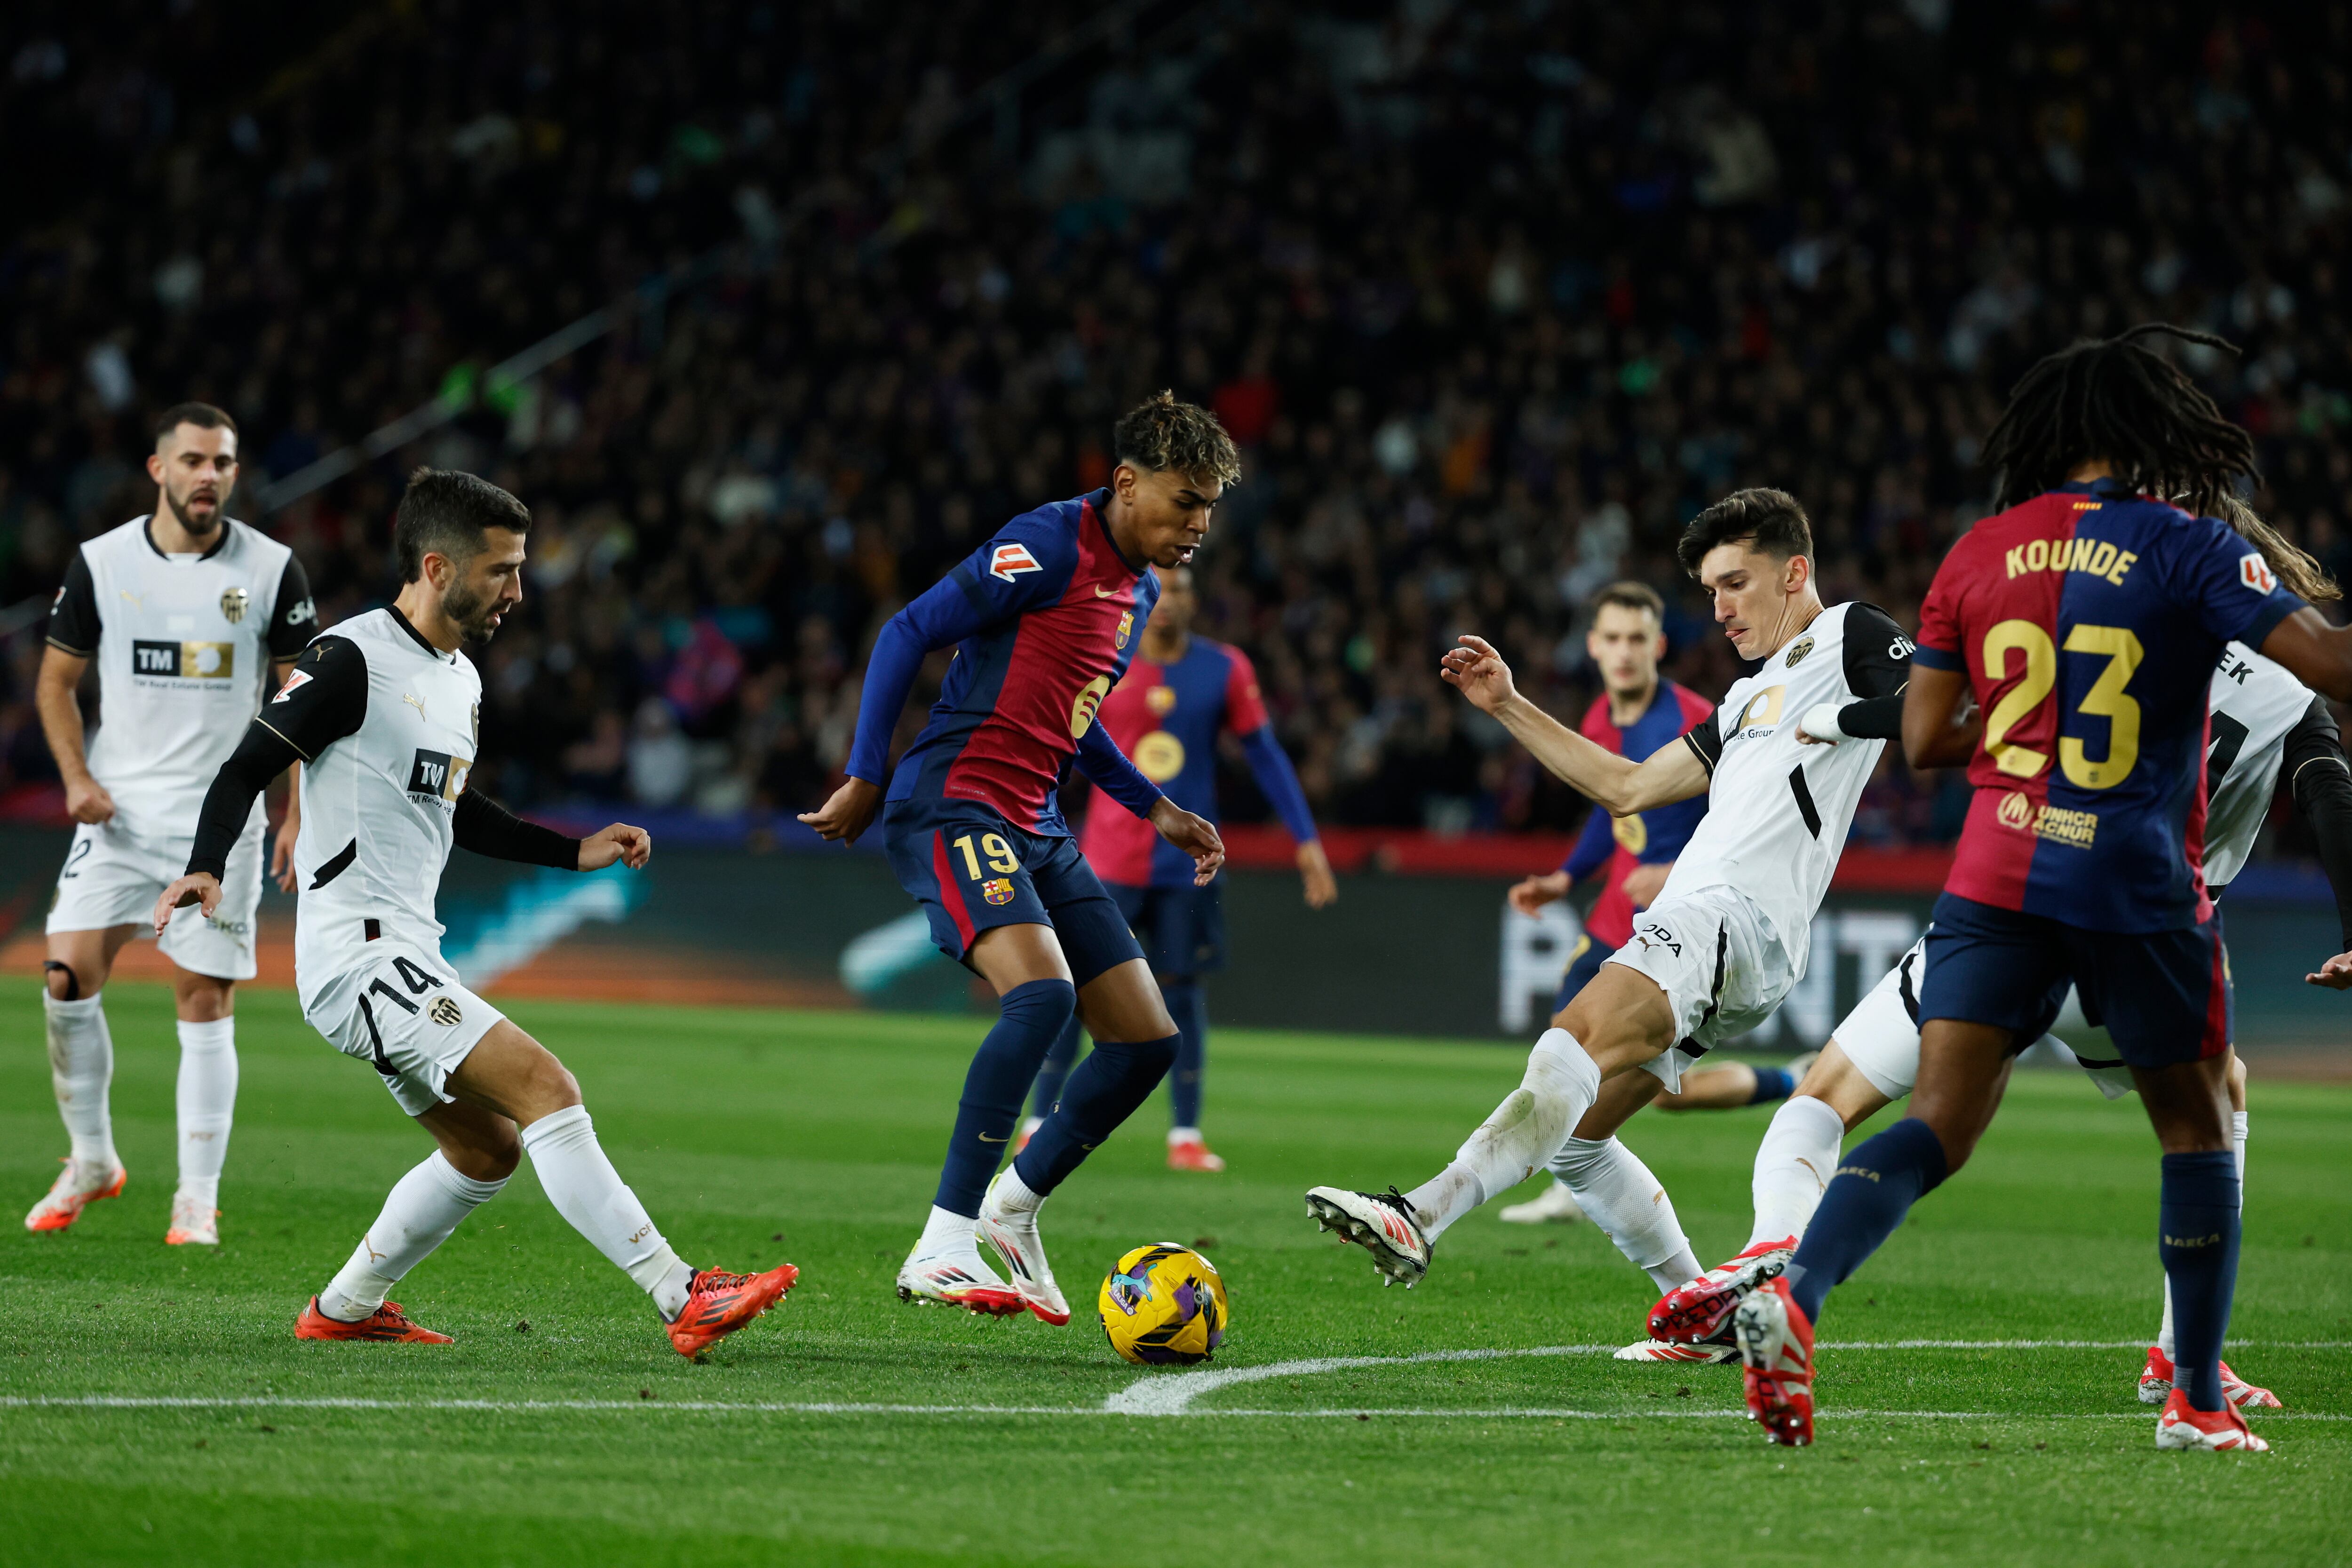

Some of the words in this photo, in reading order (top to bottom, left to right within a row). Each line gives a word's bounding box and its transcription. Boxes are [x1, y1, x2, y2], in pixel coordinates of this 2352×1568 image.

[2005, 538, 2138, 587] KOUNDE
[137, 647, 174, 671] TM
[1982, 619, 2145, 790] 23
[421, 761, 445, 788] TM
[2037, 804, 2098, 829] UNHCR
[2032, 818, 2095, 844] ACNUR
[953, 833, 1019, 881] 19
[368, 956, 445, 1016] 14
[629, 1222, 652, 1244] VCF
[1113, 1289, 1128, 1310] LALIGA
